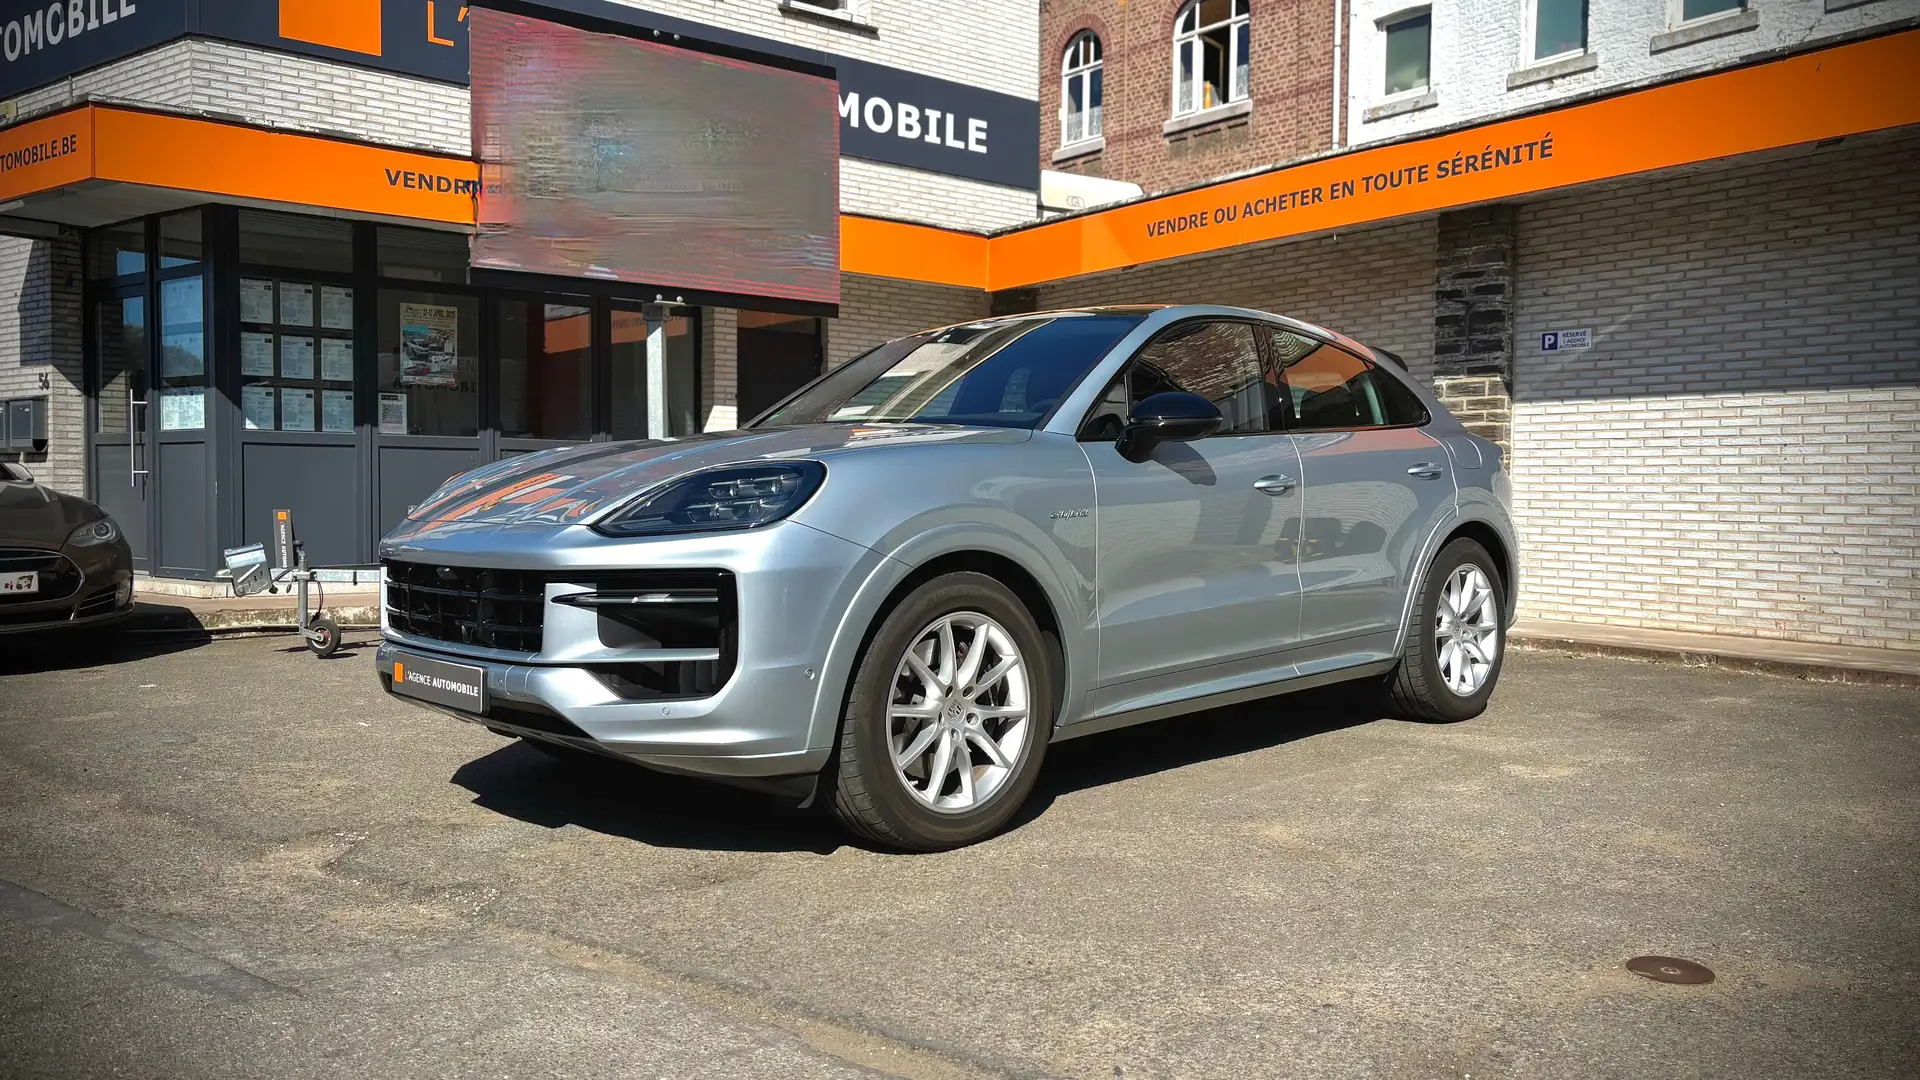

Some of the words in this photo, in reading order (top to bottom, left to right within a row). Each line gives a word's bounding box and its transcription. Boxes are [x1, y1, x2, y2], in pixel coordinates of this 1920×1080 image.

[384, 168, 482, 195] VENDR
[1147, 211, 1208, 237] VENDRE
[1214, 205, 1237, 224] OU
[1242, 186, 1323, 218] ACHETER
[1330, 179, 1355, 200] EN
[1361, 163, 1429, 193] TOUTE
[1436, 131, 1554, 179] SÉRÉNITÉ
[1545, 335, 1555, 349] P
[38, 372, 50, 390] 56
[404, 669, 431, 686] L'AGENCE
[432, 677, 479, 697] AUTOMOBILE
